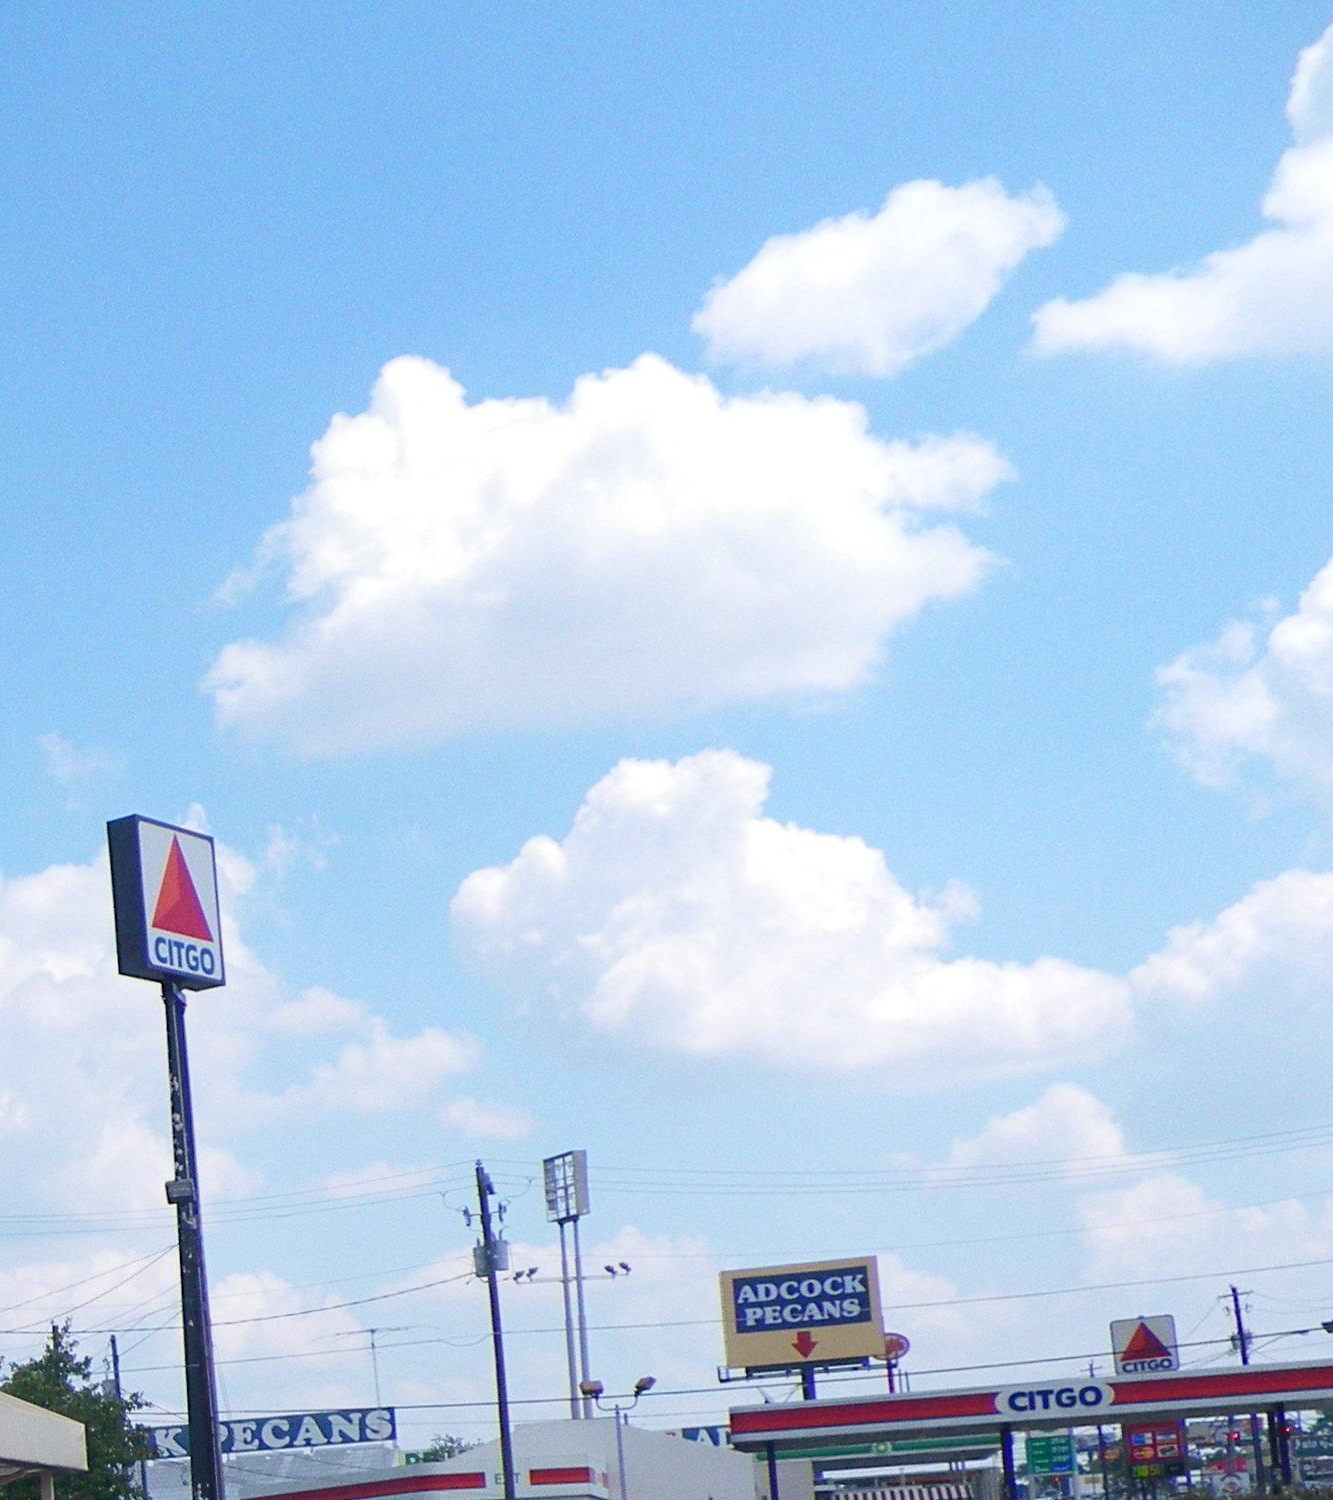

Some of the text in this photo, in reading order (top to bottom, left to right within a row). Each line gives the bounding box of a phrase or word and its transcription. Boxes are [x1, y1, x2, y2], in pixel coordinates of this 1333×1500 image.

[154, 936, 215, 975] CITGO
[737, 1273, 867, 1304] ADCOCK
[744, 1298, 862, 1326] PECANS
[1122, 1357, 1172, 1373] CITGO
[1007, 1385, 1103, 1412] CITGO
